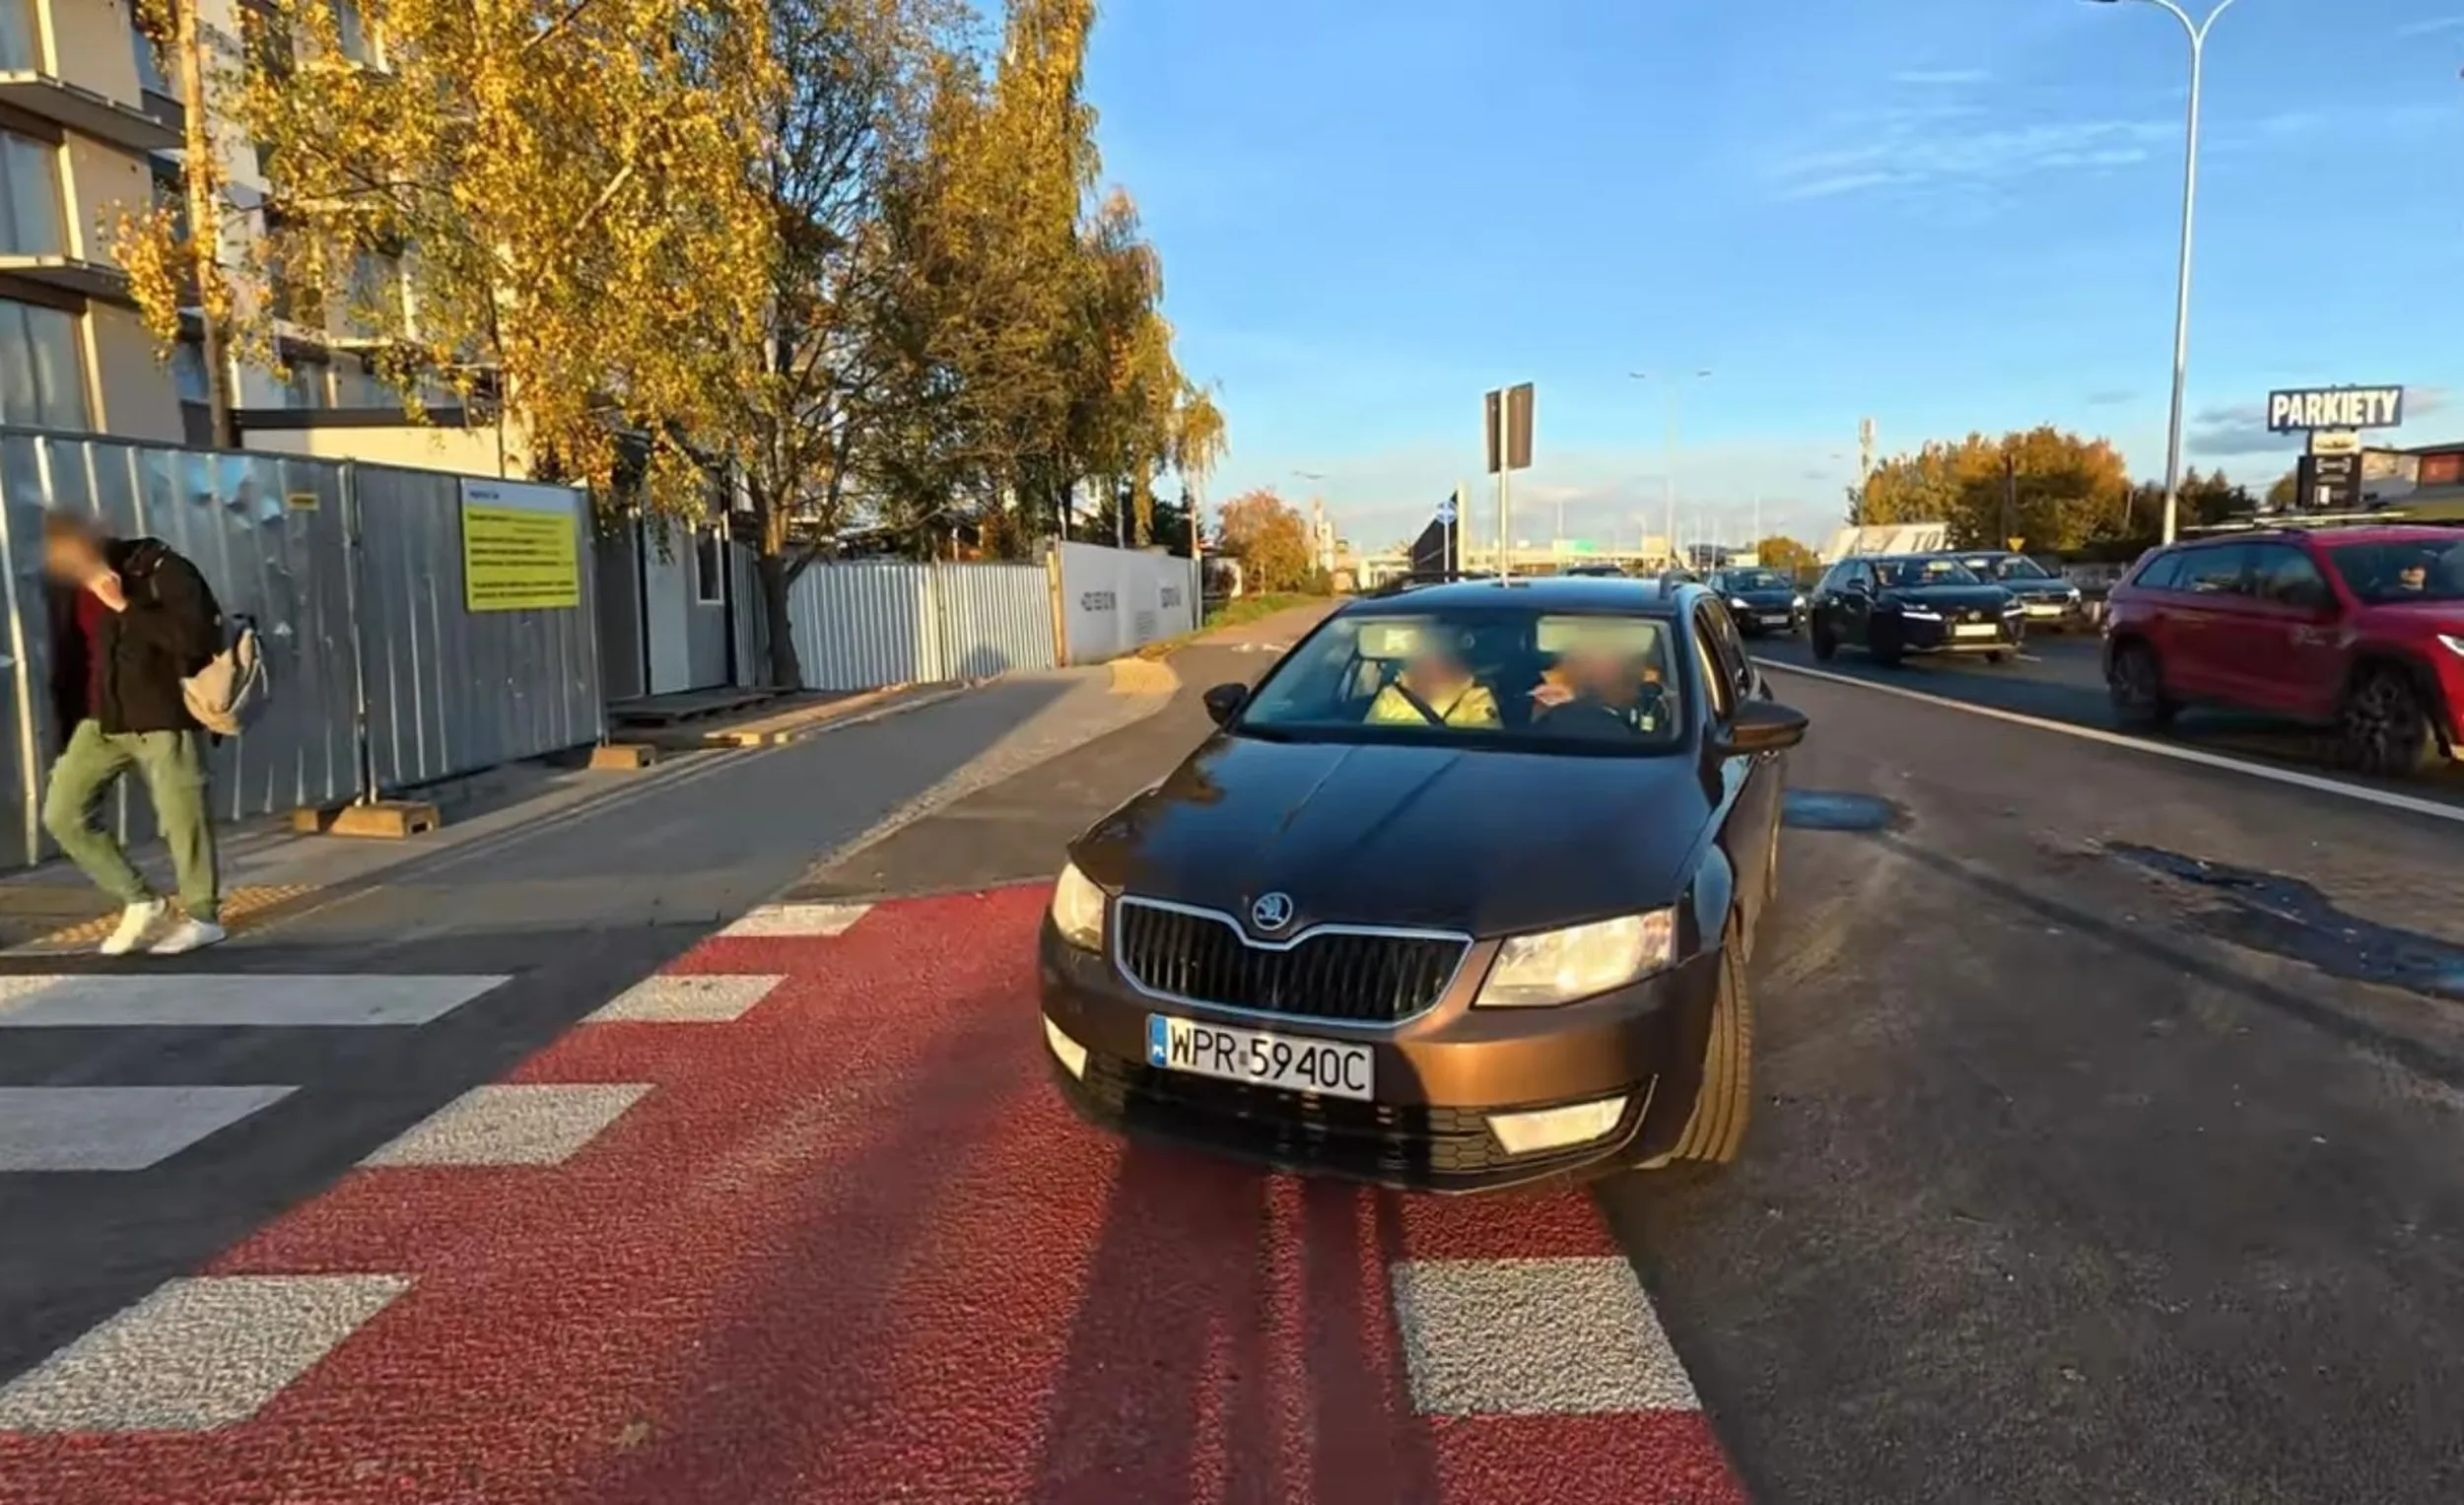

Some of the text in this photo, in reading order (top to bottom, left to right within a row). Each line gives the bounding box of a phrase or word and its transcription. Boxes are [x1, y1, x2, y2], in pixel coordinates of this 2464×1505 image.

[2272, 389, 2399, 428] PARKIETY
[1170, 1024, 1366, 1092] WPR 5940C
